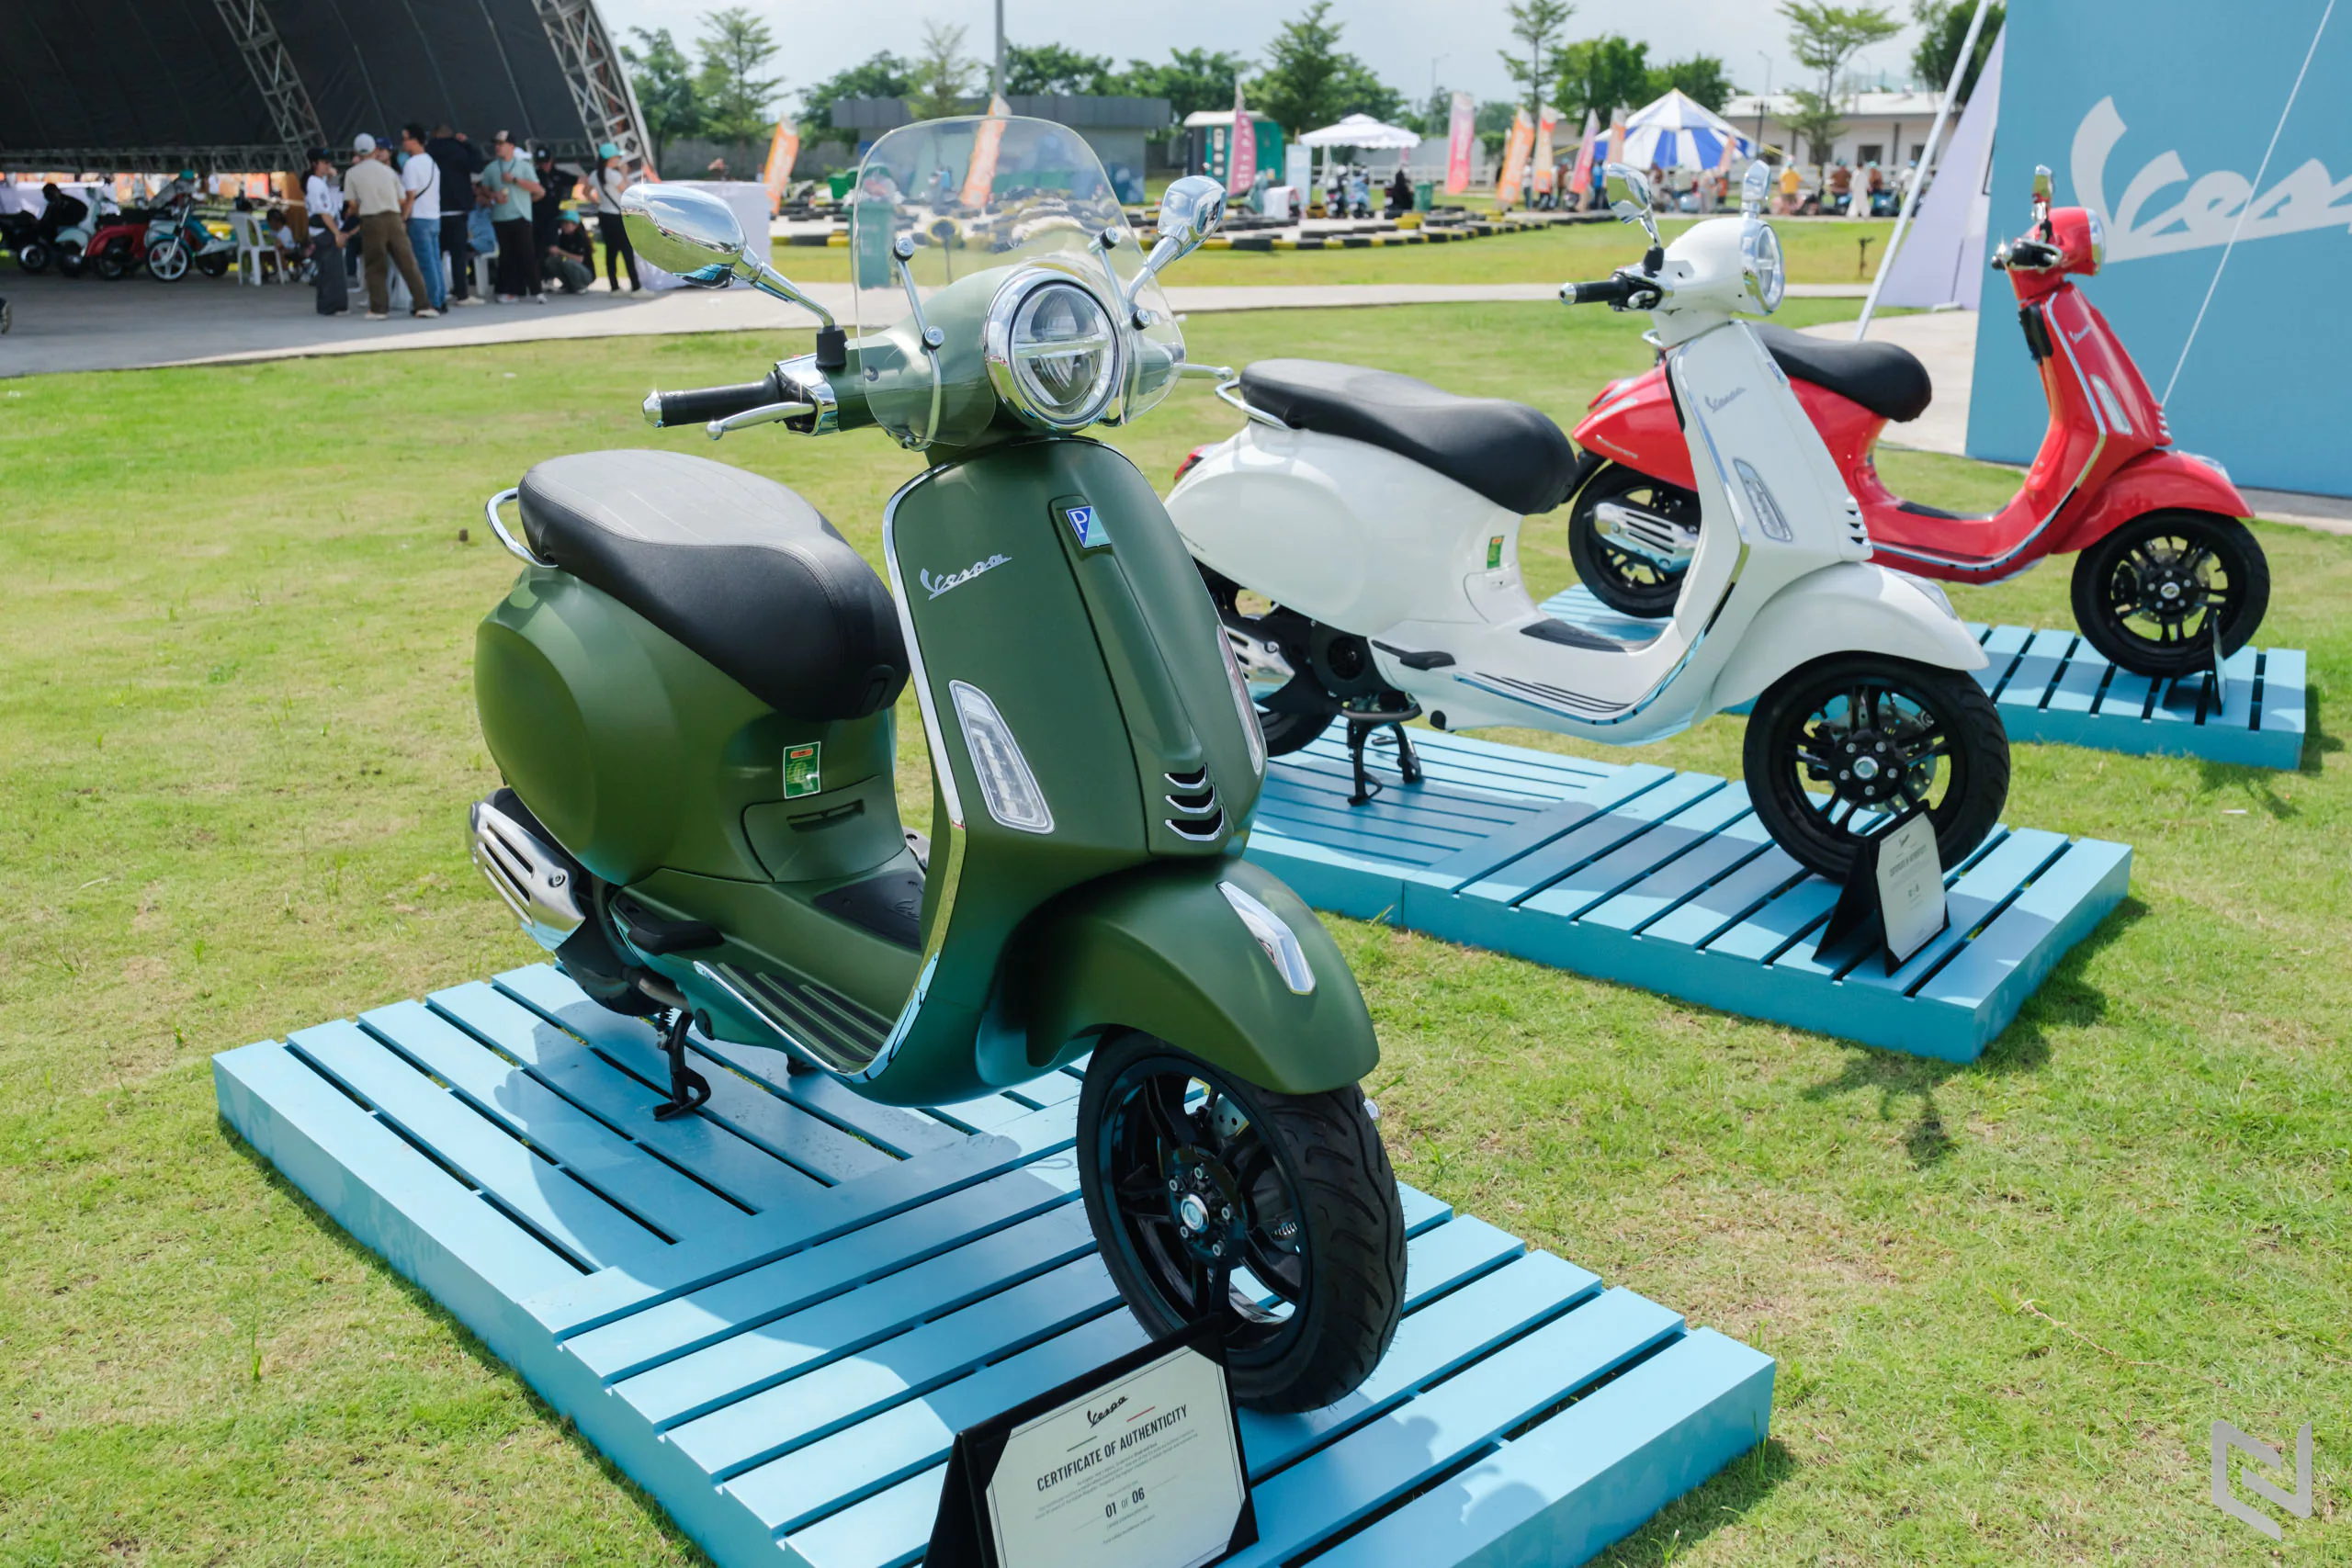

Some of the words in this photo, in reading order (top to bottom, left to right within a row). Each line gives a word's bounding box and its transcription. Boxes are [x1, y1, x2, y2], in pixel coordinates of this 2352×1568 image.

[2071, 95, 2352, 264] Ves
[1069, 510, 1089, 534] P
[920, 553, 1012, 601] Vespa
[1087, 1395, 1128, 1428] Vespa
[1036, 1448, 1102, 1492] CERTIFICATE
[1104, 1440, 1117, 1458] OF
[1119, 1404, 1188, 1452] AUTHENTICITY
[1105, 1501, 1116, 1517] 01
[1132, 1486, 1145, 1504] 06
